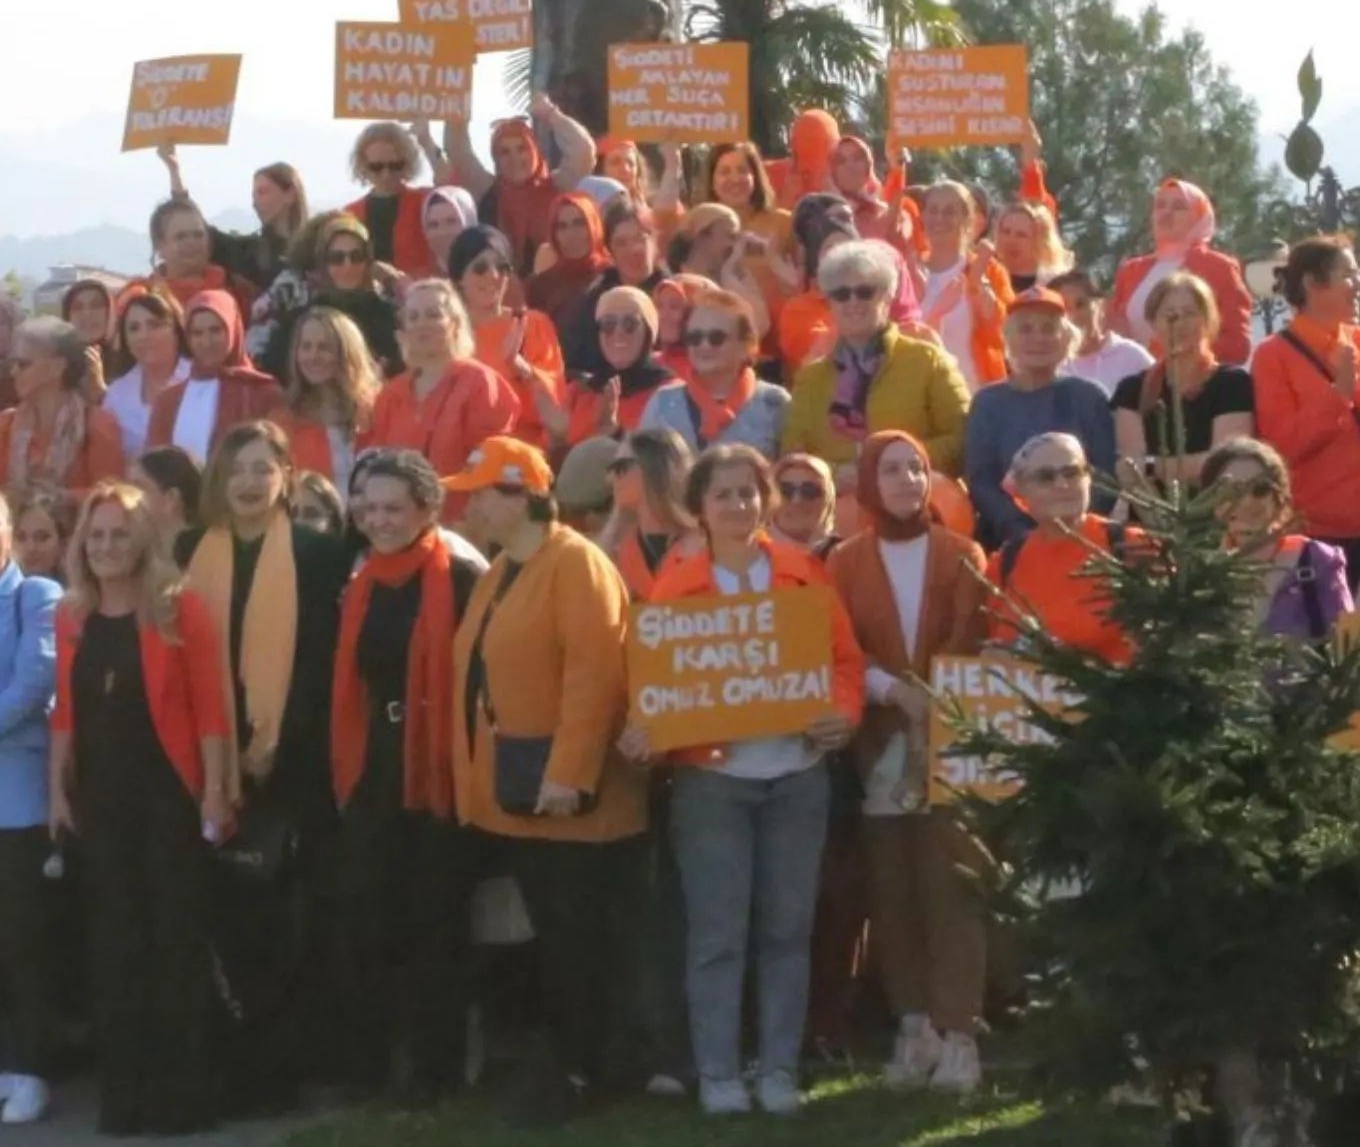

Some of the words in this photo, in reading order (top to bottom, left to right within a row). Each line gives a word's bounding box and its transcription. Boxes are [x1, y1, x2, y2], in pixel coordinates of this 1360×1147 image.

[344, 28, 435, 57] KADIN
[666, 84, 726, 109] SUÇA
[636, 600, 776, 650] ŞİDDETE
[672, 636, 780, 675] KARŞI
[638, 680, 716, 717] OMUZ
[721, 663, 833, 706] OMUZA!
